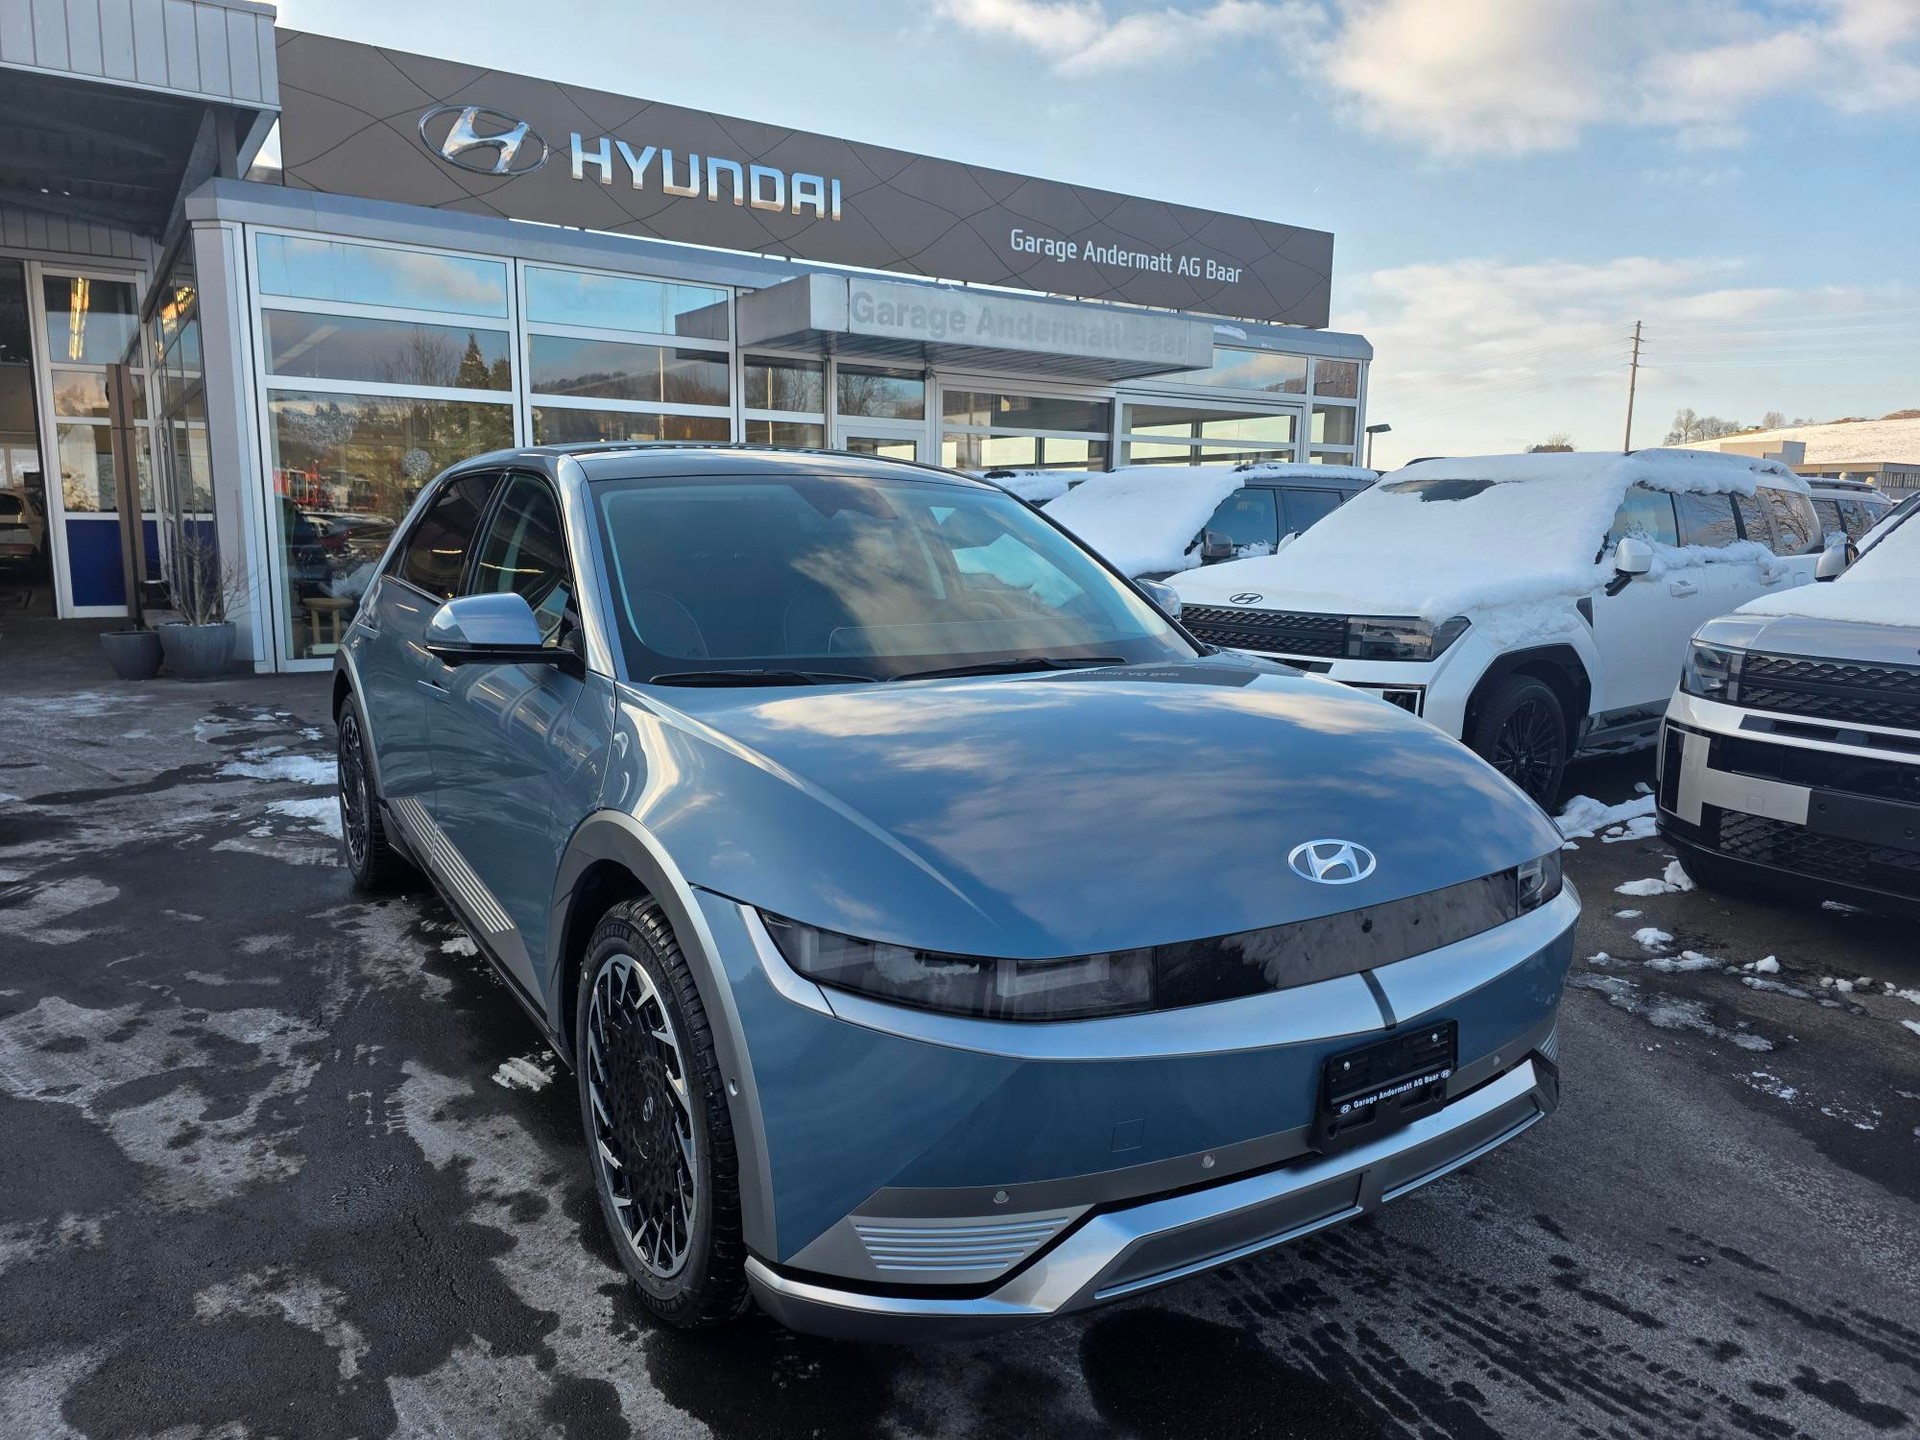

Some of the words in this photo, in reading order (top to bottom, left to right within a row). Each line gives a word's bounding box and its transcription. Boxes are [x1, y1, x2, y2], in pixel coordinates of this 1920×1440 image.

[569, 131, 842, 221] HYUNDAI
[1010, 228, 1077, 263] Garage
[1083, 240, 1173, 275] Andermatt
[1177, 255, 1201, 277] AG
[1206, 259, 1242, 283] Baar
[850, 291, 968, 339] Garage
[976, 306, 1123, 348] Andermatt
[1353, 1095, 1377, 1109] Garage
[1379, 1082, 1412, 1100] Andermatt
[1413, 1078, 1423, 1088] AG
[1424, 1073, 1439, 1084] Baar
